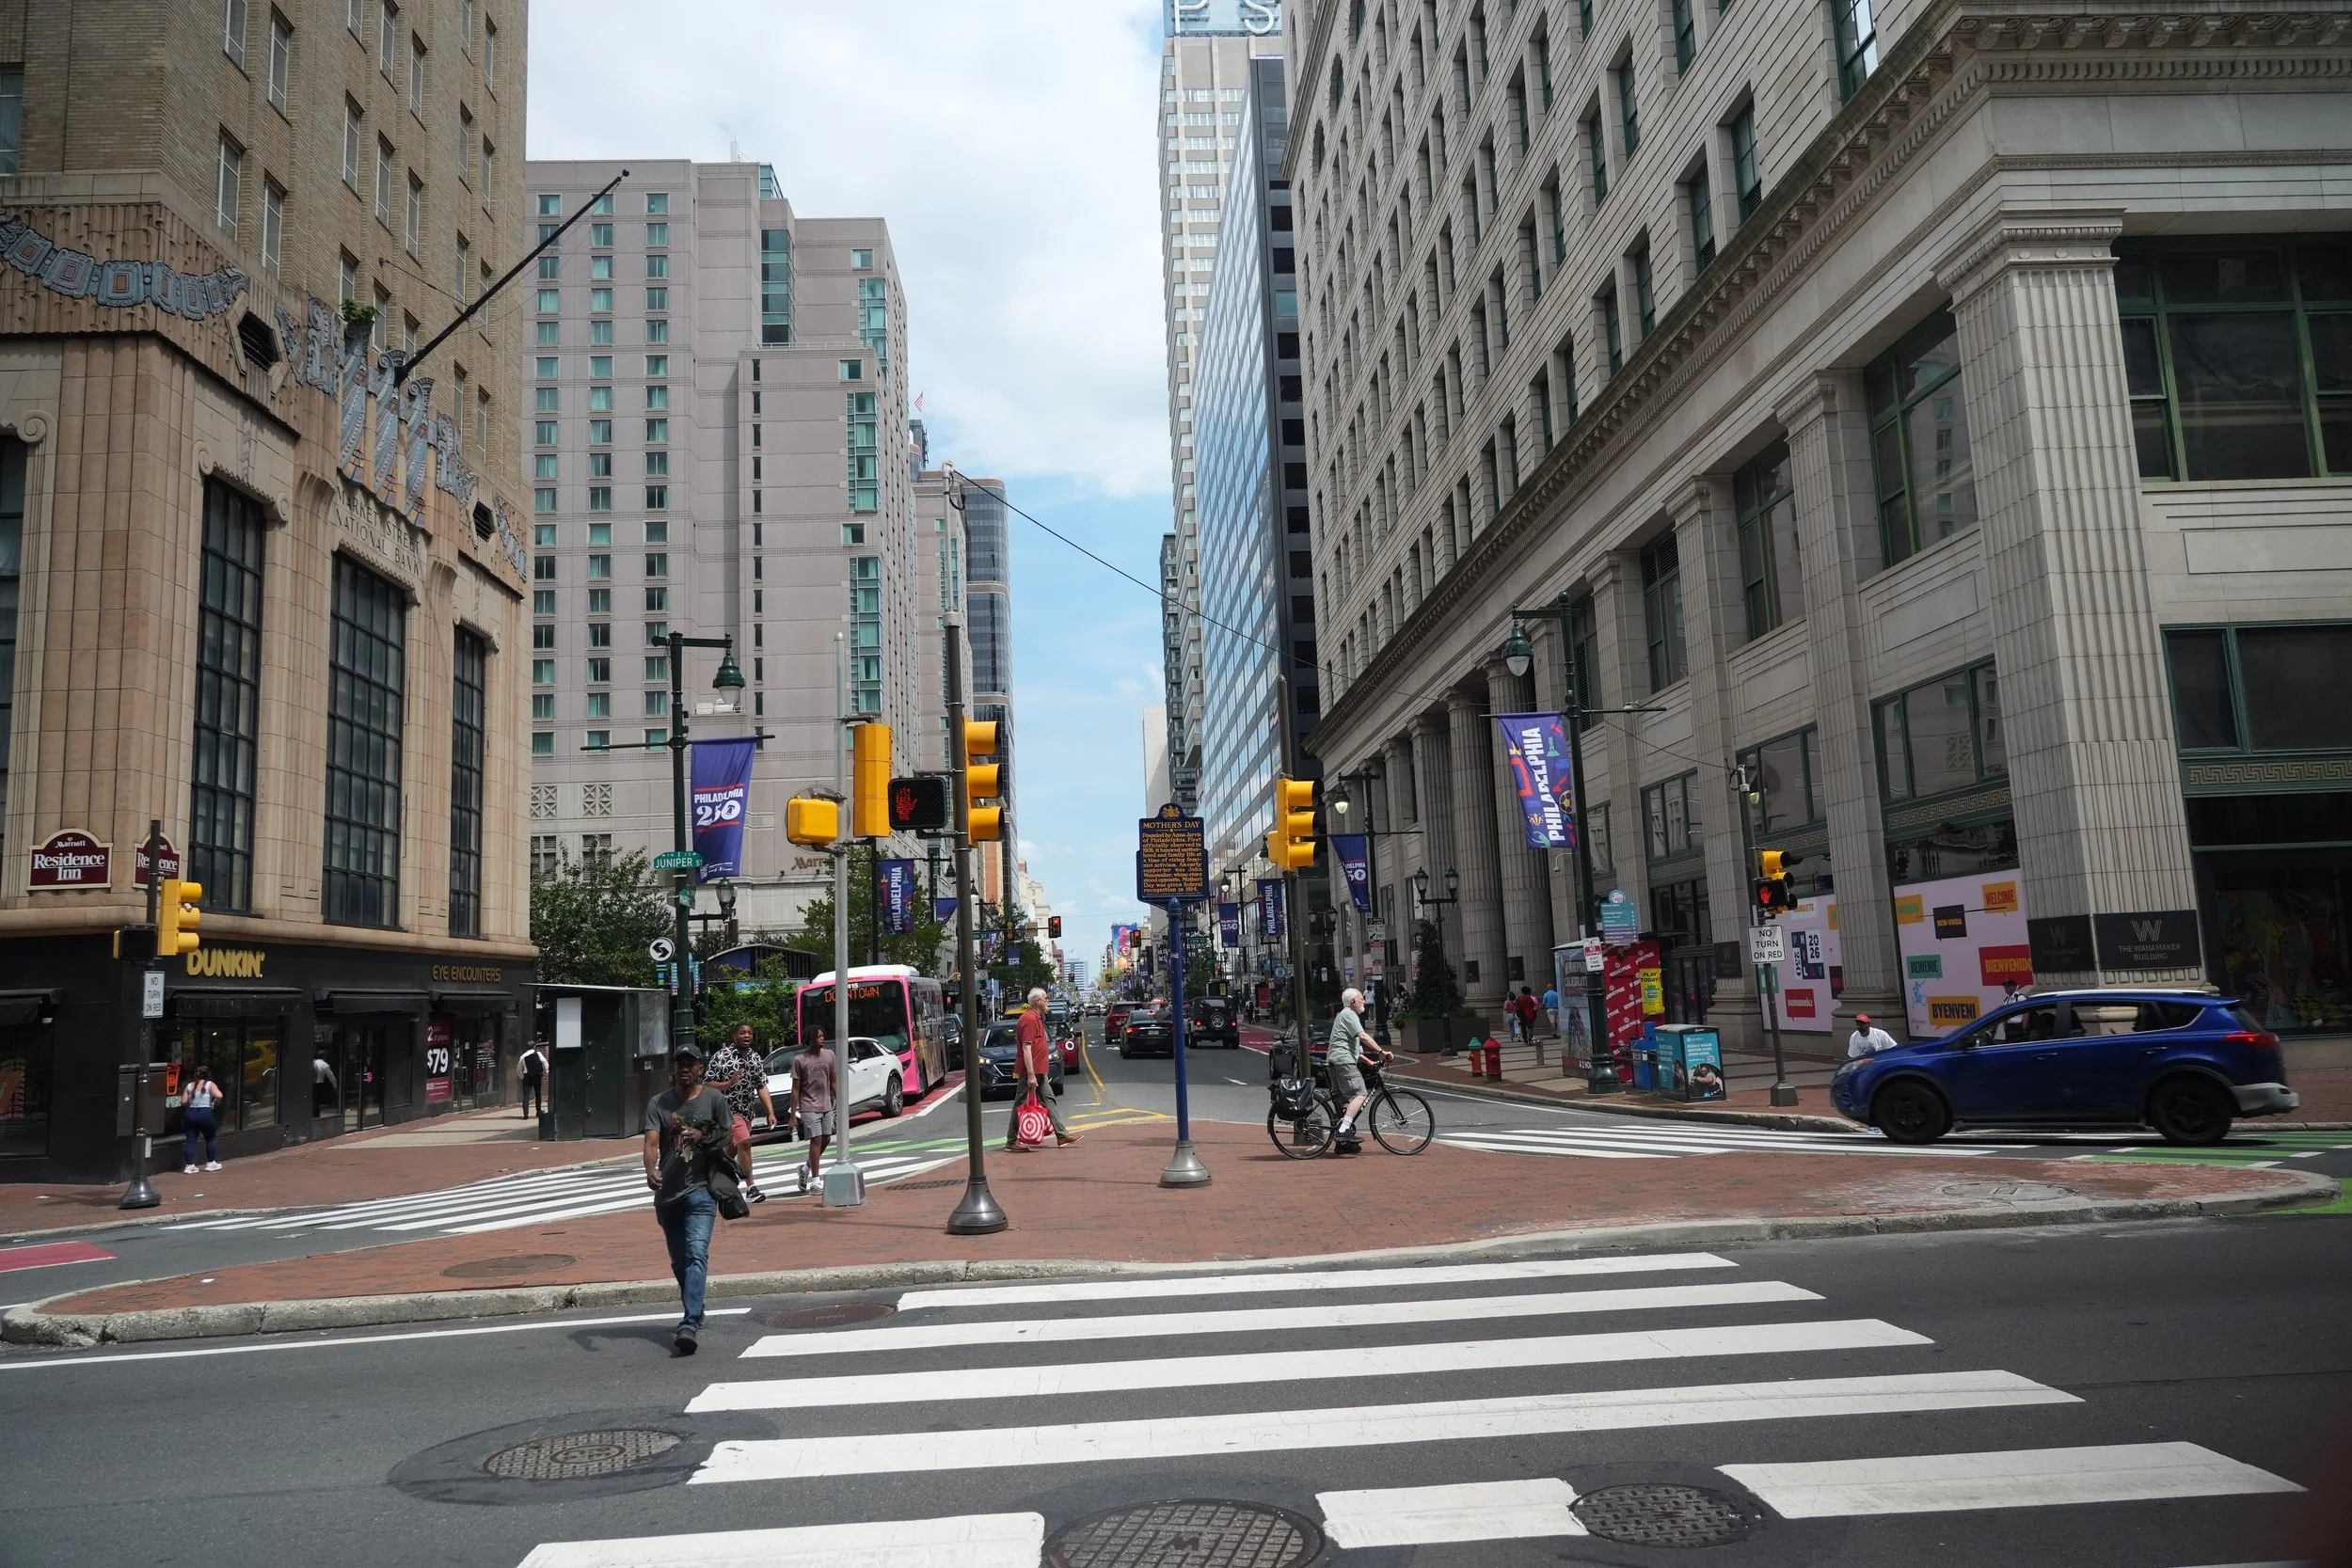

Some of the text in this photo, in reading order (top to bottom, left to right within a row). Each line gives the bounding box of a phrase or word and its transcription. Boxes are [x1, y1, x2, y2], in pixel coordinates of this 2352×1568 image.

[337, 486, 420, 555] MARKET STREET
[336, 508, 420, 577] NATIONAL BANK
[696, 800, 740, 827] 250
[55, 840, 87, 848] Marriott
[33, 852, 105, 870] Residence
[136, 851, 178, 871] Reence
[655, 858, 692, 868] JUNIPER
[791, 856, 828, 871] Marr
[56, 866, 83, 881] Inn
[1345, 868, 1367, 882] 50
[890, 866, 903, 931] PHILADELPHIA
[1984, 890, 2015, 906] WELCOME
[1264, 884, 1277, 934] PHILADELPHIA
[1758, 929, 1772, 938] NO
[2131, 919, 2162, 942] W
[1808, 934, 1819, 946] 20
[1754, 950, 1783, 959] ON RED
[1810, 946, 1820, 958] 26
[2134, 943, 2181, 953] WANAMAKER
[187, 948, 265, 978] DUNKIN'
[2134, 953, 2168, 961] BUILDING
[433, 965, 501, 982] EYE ENCOUNTERS
[1910, 960, 1939, 974] BIENVENUE
[151, 976, 158, 986] NO
[148, 990, 161, 999] TURN
[824, 986, 880, 1003] DONTOWN
[145, 1003, 162, 1012] ON RED
[1931, 1003, 1976, 1020] BYENVENI
[427, 1026, 433, 1042] 2
[427, 1048, 449, 1073] $79
